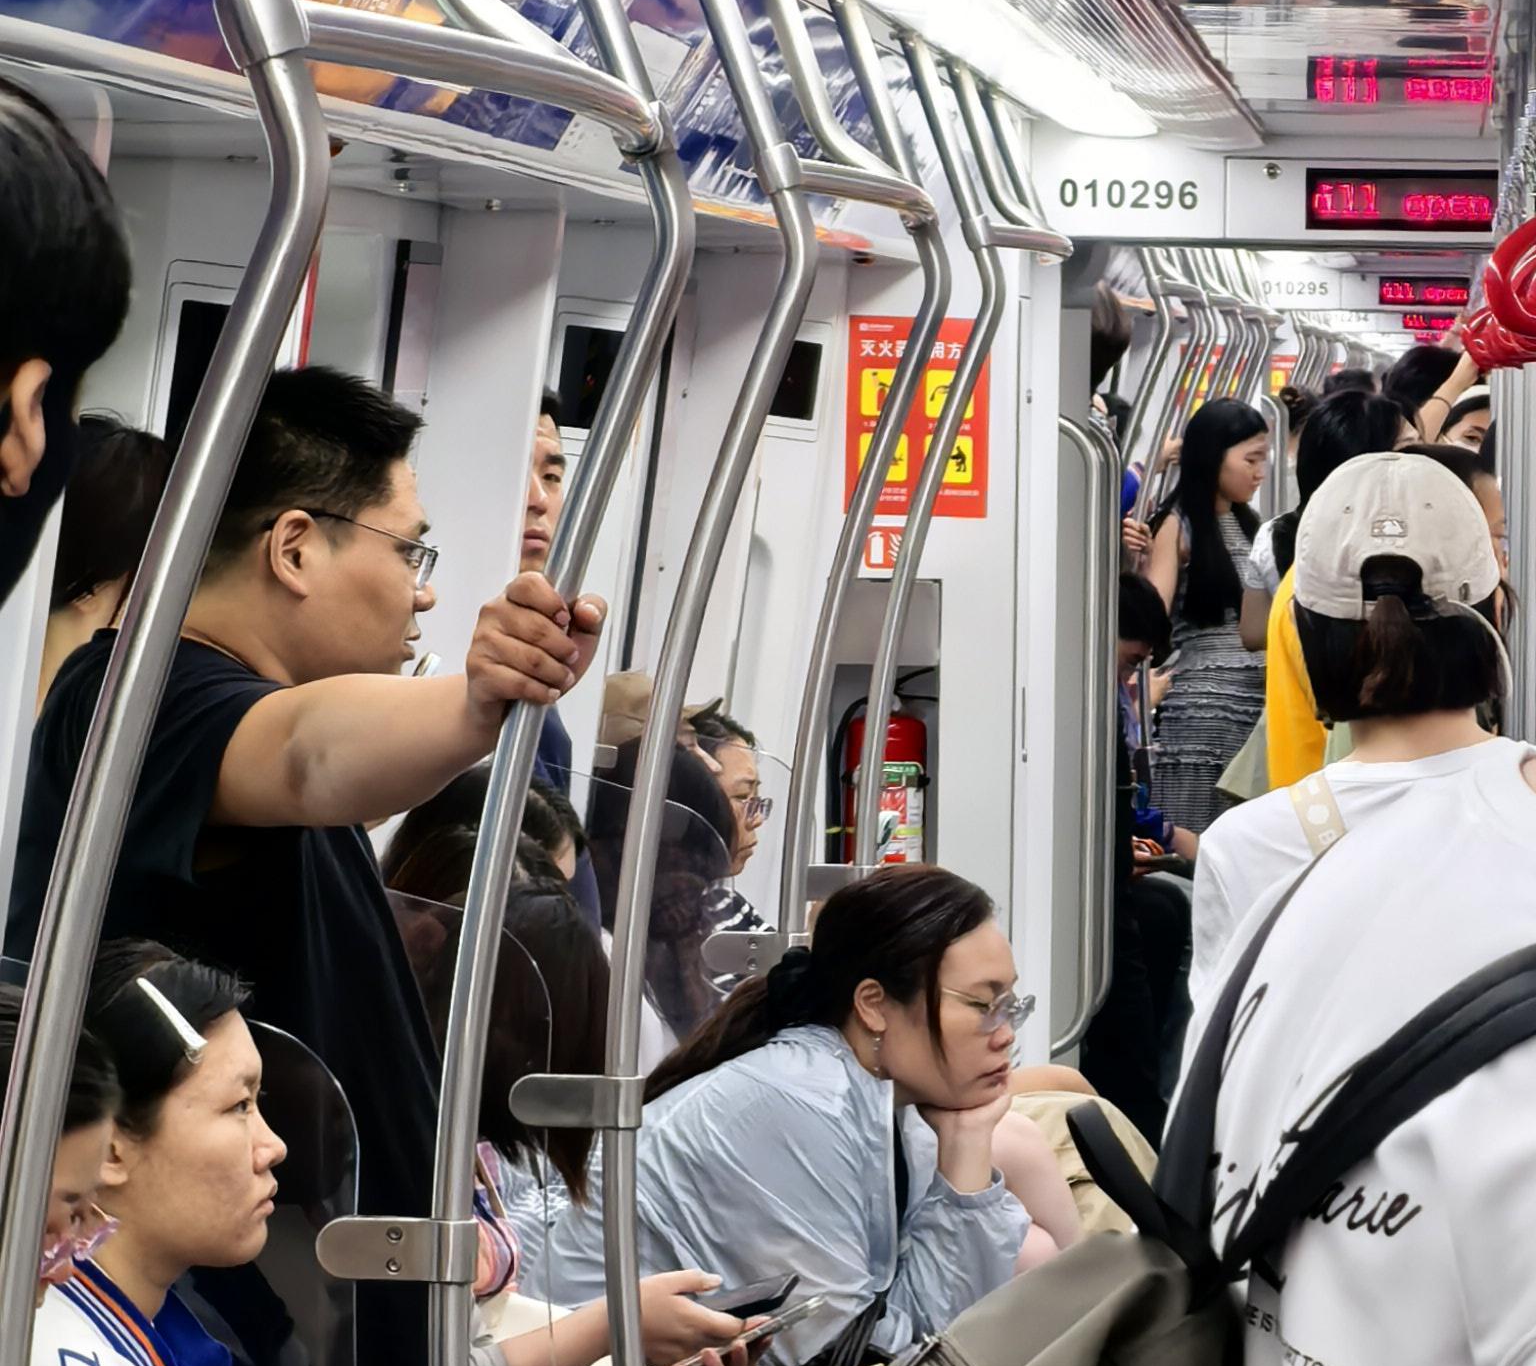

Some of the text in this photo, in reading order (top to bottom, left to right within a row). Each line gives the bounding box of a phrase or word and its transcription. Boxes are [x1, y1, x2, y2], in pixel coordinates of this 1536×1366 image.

[1059, 178, 1199, 210] 010296
[1404, 195, 1494, 221] open
[1264, 280, 1329, 296] 010295
[860, 339, 965, 359] 灭火器用方
